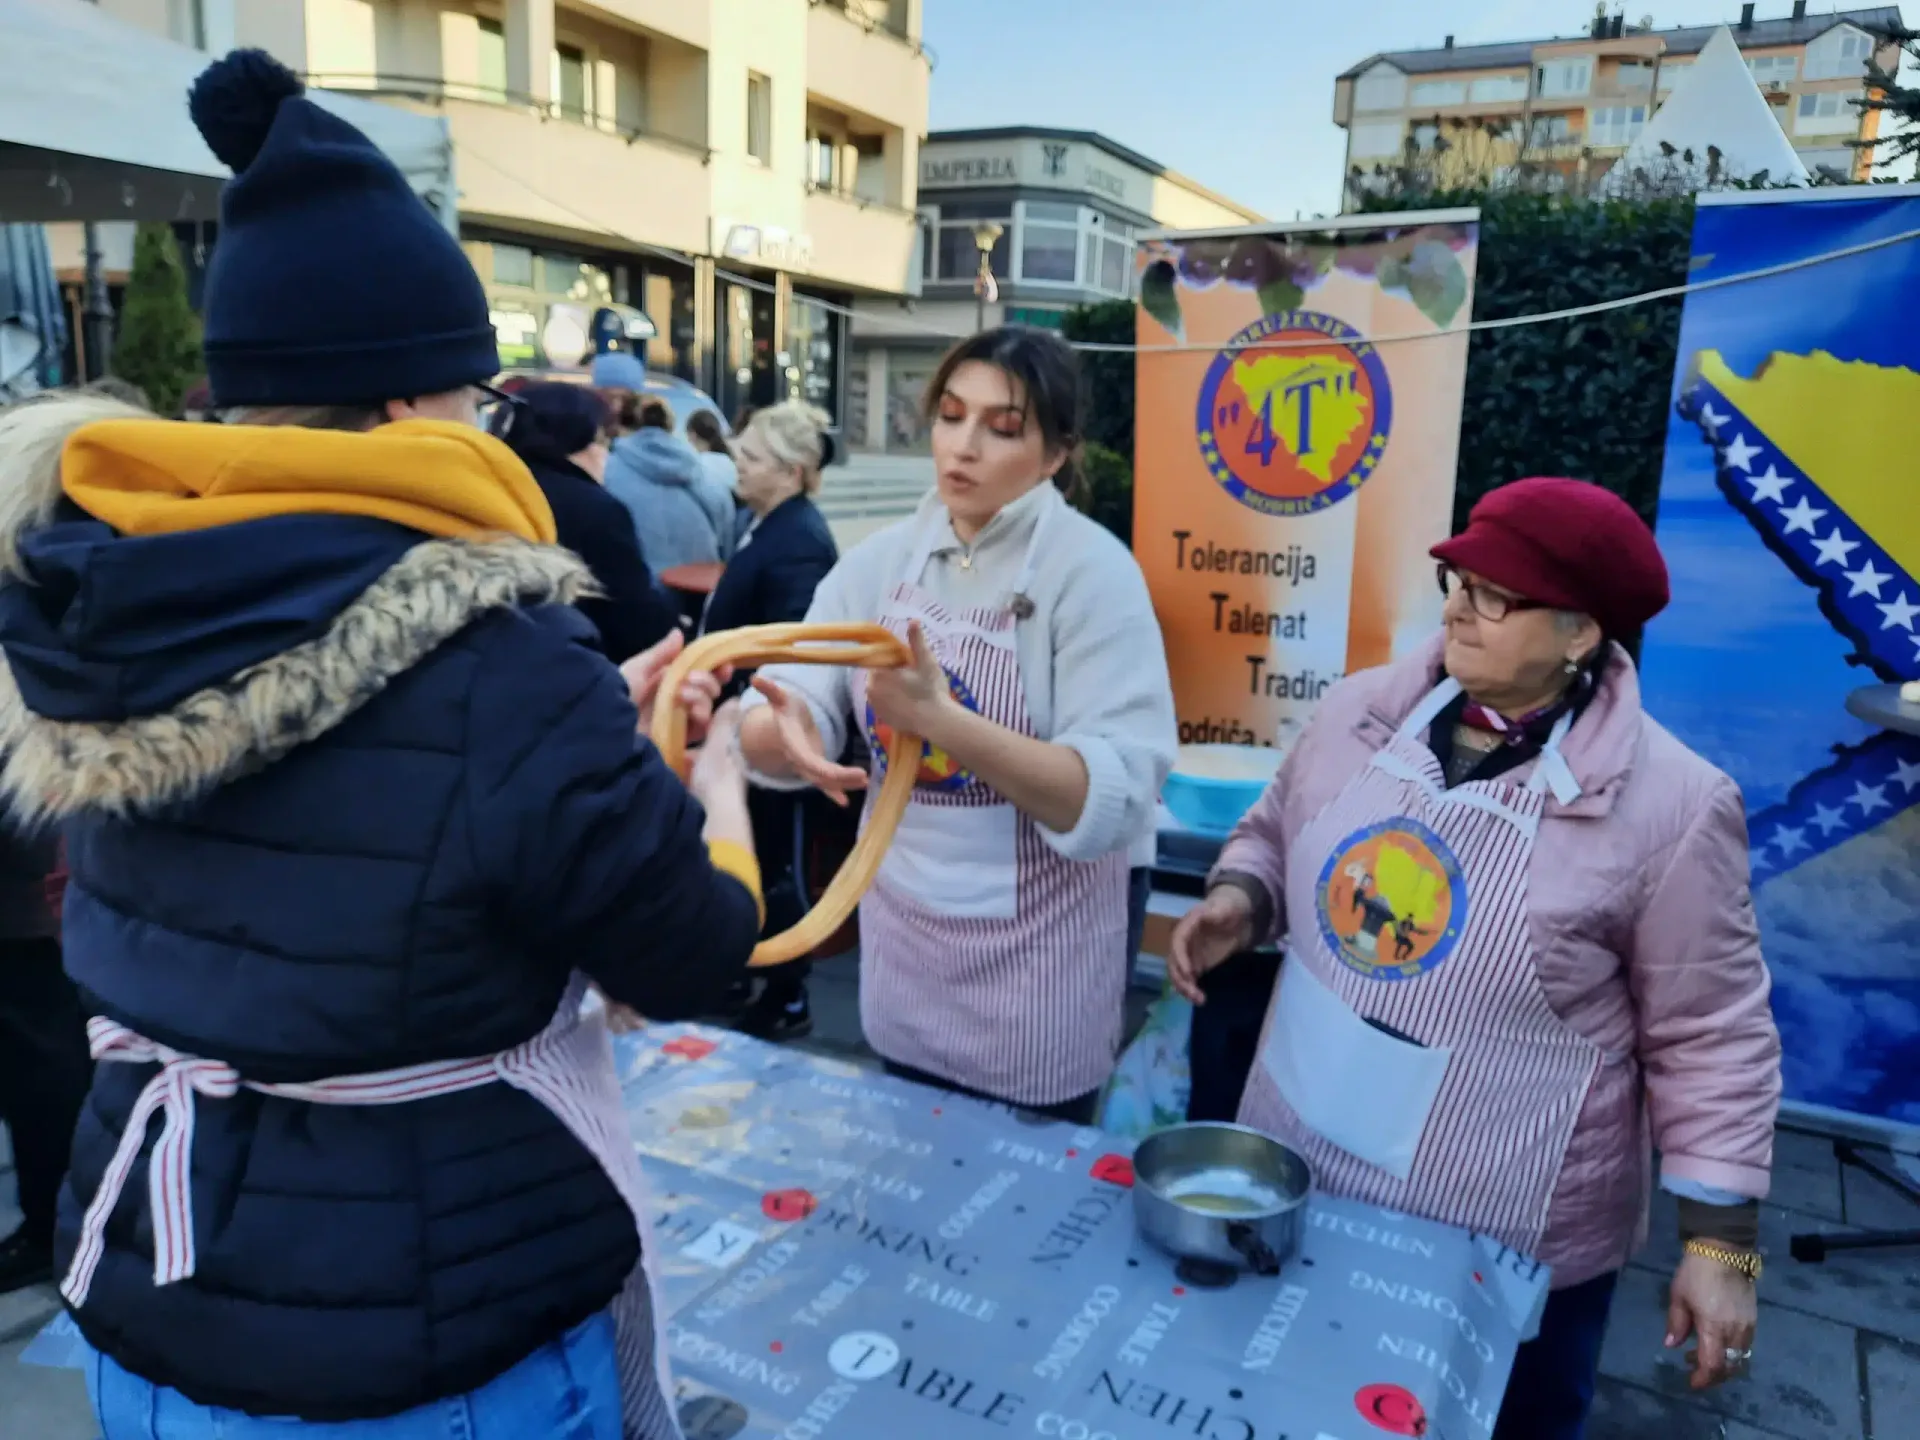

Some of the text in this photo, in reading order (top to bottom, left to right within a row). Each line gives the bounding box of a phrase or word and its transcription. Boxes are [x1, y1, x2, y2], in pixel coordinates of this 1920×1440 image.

[1173, 530, 1317, 587] Tolerancija
[1210, 592, 1308, 641] Talenat
[904, 1272, 1000, 1323] TABLE
[1349, 1270, 1494, 1363] COOKING
[852, 1336, 1027, 1428] TABLE
